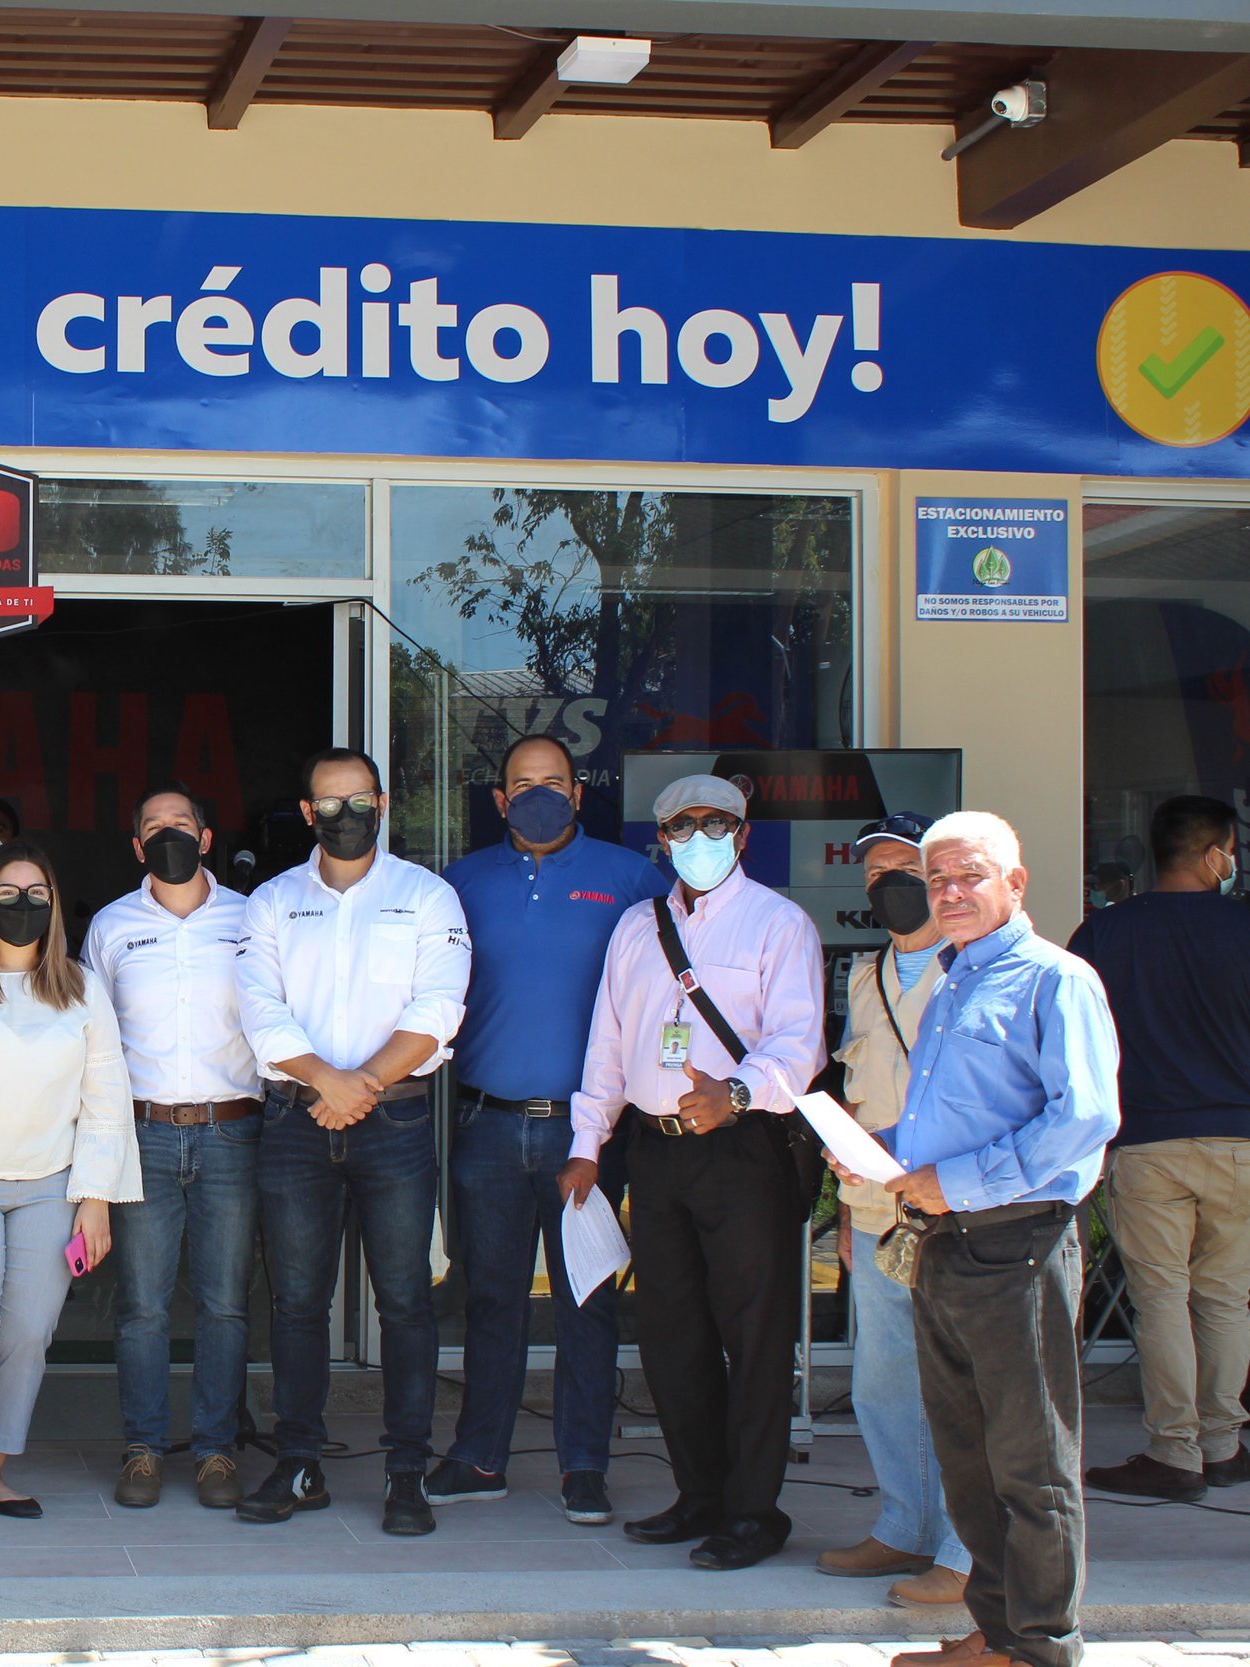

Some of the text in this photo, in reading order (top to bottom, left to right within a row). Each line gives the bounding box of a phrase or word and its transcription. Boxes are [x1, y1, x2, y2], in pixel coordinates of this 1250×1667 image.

[35, 262, 550, 383] crédito
[590, 274, 884, 424] hoy!
[917, 507, 1065, 521] ESTACIONAMIENTO
[947, 525, 1036, 539] EXCLUSIVO
[6, 598, 20, 607] DE
[23, 599, 34, 607] TI
[924, 597, 937, 605] NO
[971, 598, 1039, 607] RESPONSABLES
[1041, 599, 1060, 607] POR
[919, 606, 949, 616] DAÑOS
[950, 608, 967, 616] Y/O
[969, 608, 999, 616] ROBOS
[1008, 609, 1021, 617] SU
[1023, 609, 1065, 617] VEHICULO
[757, 775, 860, 801] YAMAHA
[299, 910, 324, 919] YAMAHA
[134, 937, 158, 948] YAMAHA
